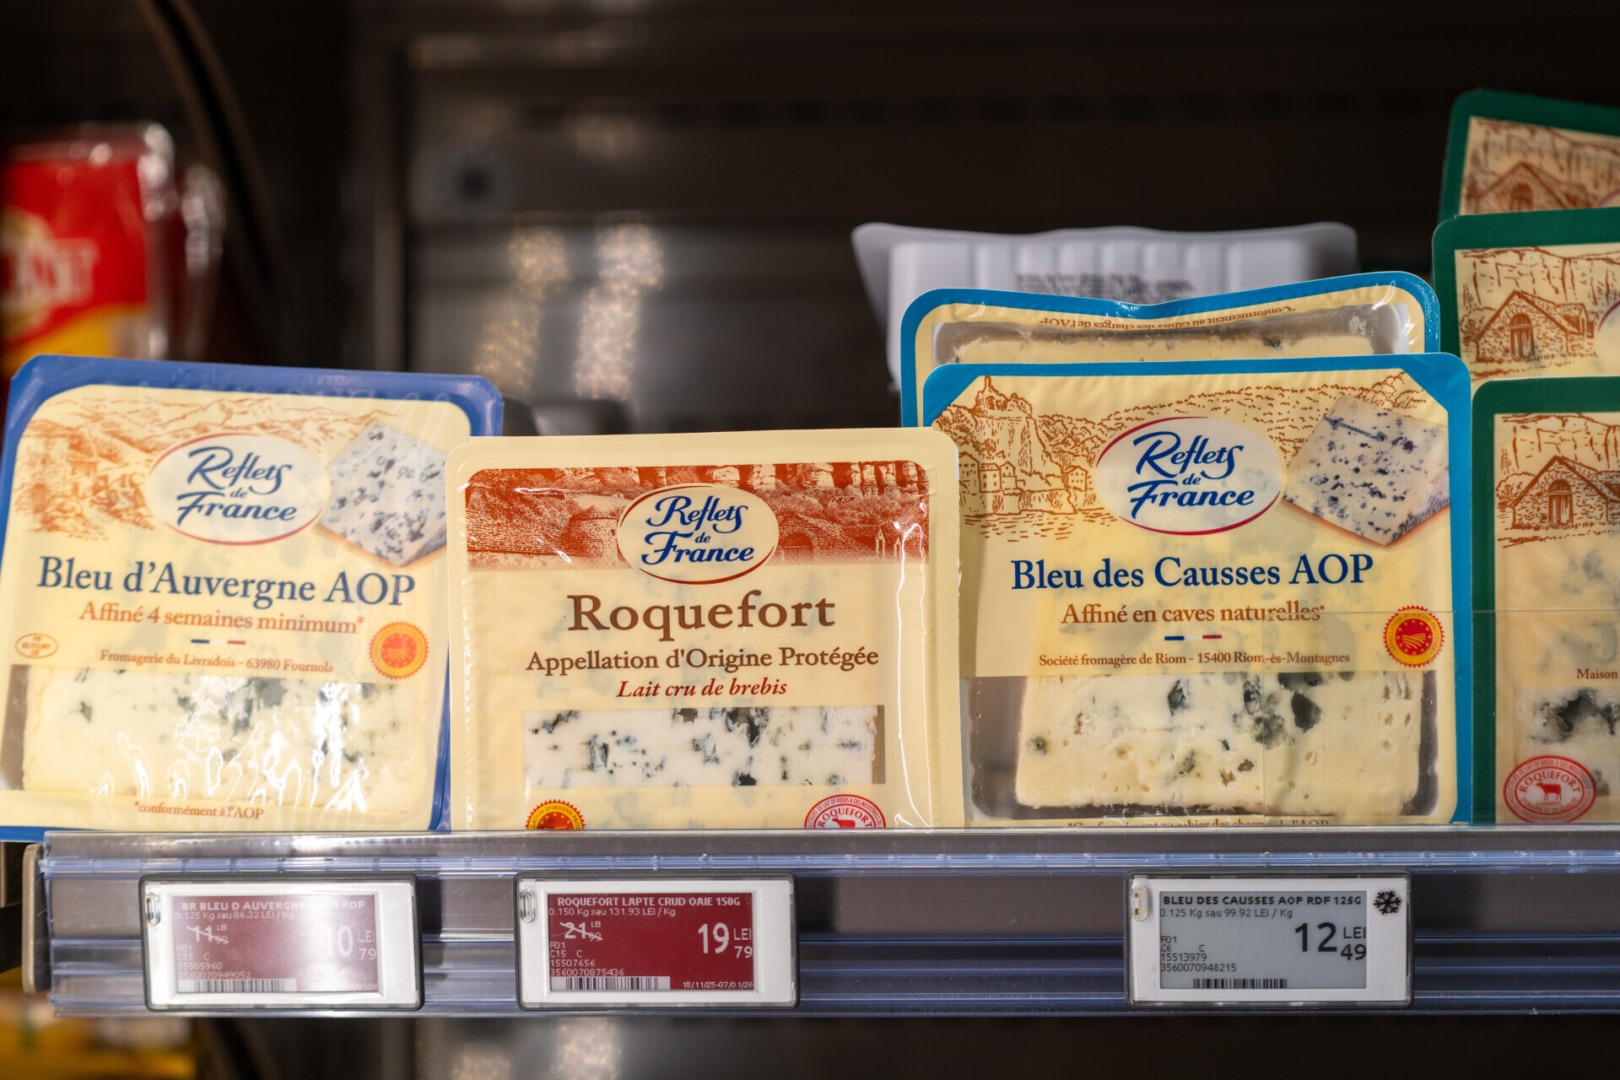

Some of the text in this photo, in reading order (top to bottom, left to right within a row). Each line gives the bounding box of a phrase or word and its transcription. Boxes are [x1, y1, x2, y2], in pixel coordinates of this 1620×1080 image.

[1078, 320, 1092, 328] de
[1132, 430, 1245, 480] Reflets
[187, 445, 293, 495] Reflets
[1182, 474, 1200, 486] de
[230, 488, 248, 499] de
[1127, 479, 1255, 520] France
[177, 490, 297, 527] France
[645, 494, 750, 534] Reflets
[695, 531, 711, 544] de
[640, 531, 755, 567] France
[1011, 553, 1374, 590] Bleu des Causses AOP
[37, 556, 415, 610] Bleu d'Auvergne AOP
[79, 601, 143, 624] Affiné
[148, 606, 160, 624] 4
[164, 610, 254, 630] semaines
[567, 589, 836, 642] Roquefort
[1061, 603, 1129, 624] Affiné
[1132, 608, 1157, 622] en
[1162, 606, 1215, 622] caves
[99, 649, 163, 666] Fromagerie
[166, 654, 180, 665] du
[183, 654, 235, 668] Livradois
[246, 658, 280, 670] 63980
[283, 659, 333, 673] Fournols
[525, 646, 880, 677] Appellation d'Origine Protégée
[1039, 654, 1079, 666] Société
[1081, 653, 1137, 669] fromagère
[1138, 653, 1153, 664] de
[1155, 652, 1187, 664] Riom
[1197, 652, 1231, 664] 15400
[1576, 668, 1618, 680] Maison
[616, 677, 788, 699] Lait cru de brebis
[1519, 770, 1581, 793] ROQUEFORT
[817, 808, 873, 828] ROQUEFORT
[181, 902, 197, 911] BR
[200, 902, 228, 911] BLEU
[232, 902, 240, 911] D
[342, 901, 366, 911] RDF
[558, 897, 741, 907] ROQUEFORT LAPTE CRUD OAIE 150G
[1163, 896, 1361, 905] BLEU DES CAUSSES AOP RDF 125G
[203, 912, 215, 921] Kg
[233, 911, 260, 919] 86.32
[261, 911, 275, 919] LEI
[548, 908, 574, 916] 0.150
[577, 908, 589, 917] Kg
[663, 908, 676, 917] Kg
[1160, 909, 1187, 917] 0.125
[1189, 909, 1202, 919] Kg
[1223, 909, 1252, 917] 99.92
[1254, 908, 1269, 917] LEI
[1280, 909, 1293, 919] Kg
[357, 930, 375, 943] LEI
[564, 922, 586, 939] 21
[698, 922, 752, 954] 19 LEI
[1295, 922, 1366, 953] 12 LEI
[359, 948, 376, 960] 79
[734, 946, 753, 958] 79
[1198, 944, 1206, 952] C
[1340, 944, 1367, 961] 49
[551, 959, 595, 967] 15507656
[1160, 953, 1207, 961] 15513979
[551, 968, 624, 976] 3560070875436
[1160, 963, 1237, 972] 3560070948215
